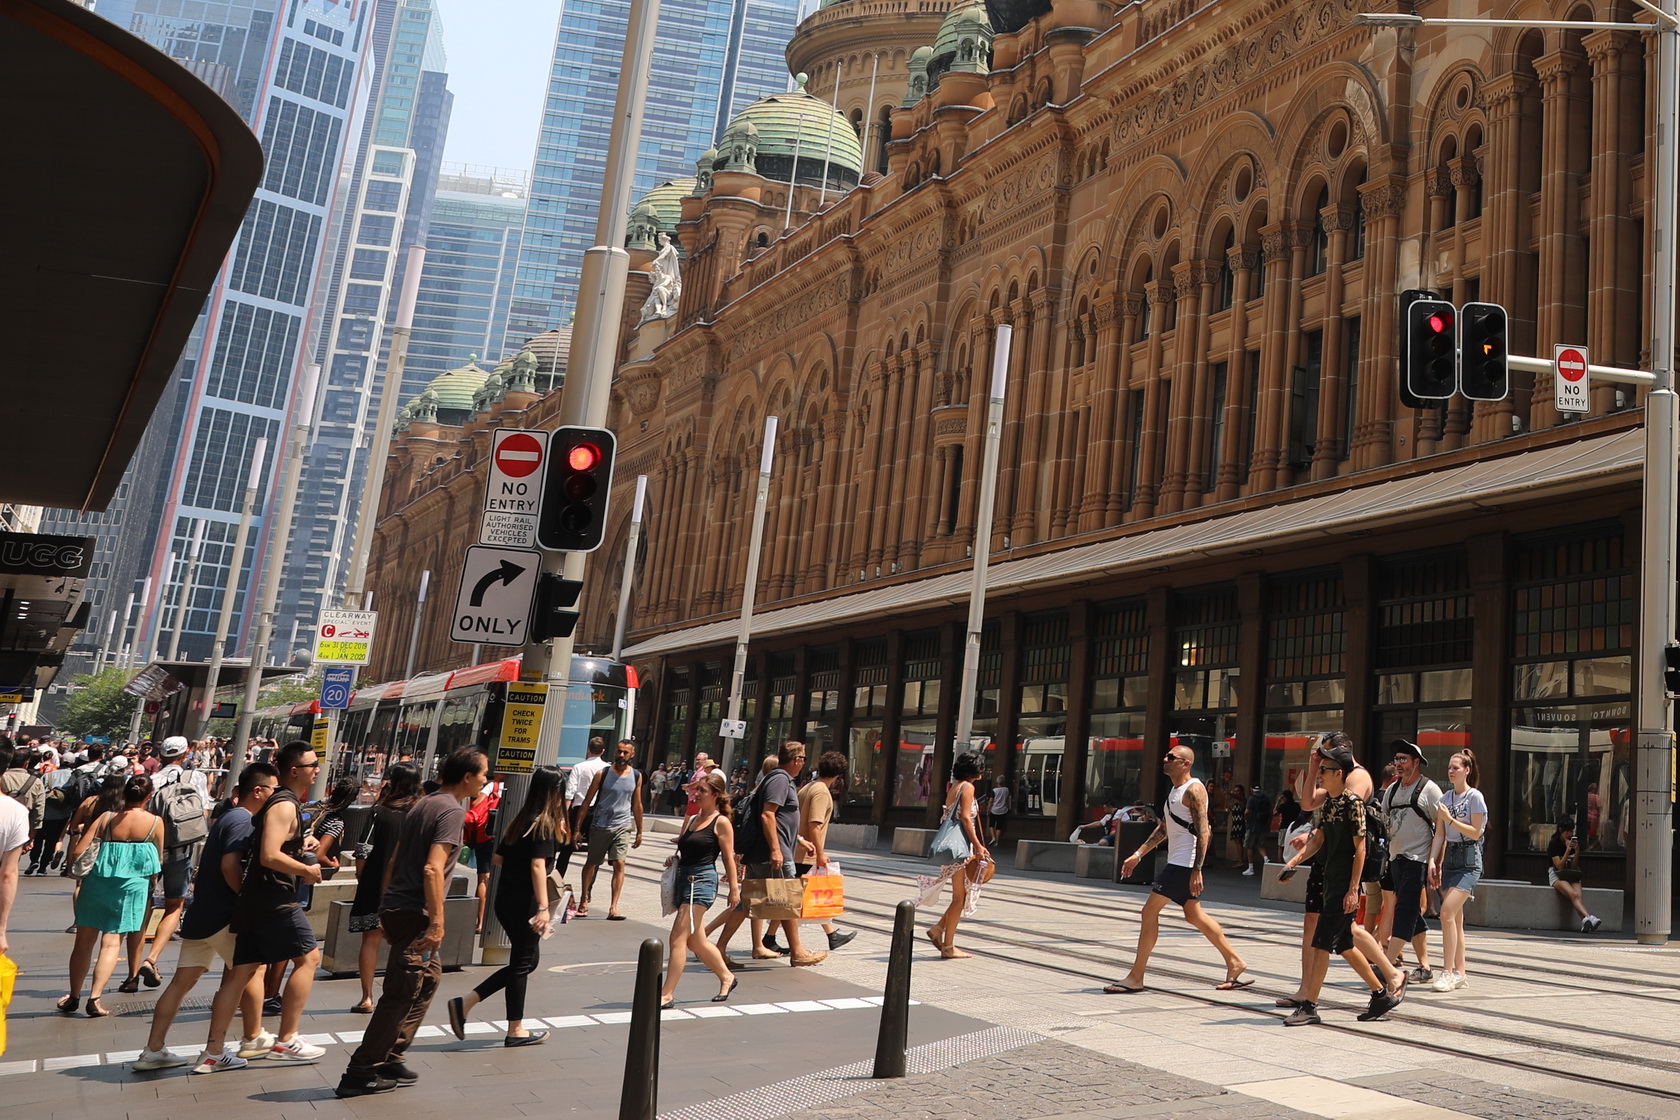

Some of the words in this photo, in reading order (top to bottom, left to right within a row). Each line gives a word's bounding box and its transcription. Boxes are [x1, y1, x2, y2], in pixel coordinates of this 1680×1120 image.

[1564, 385, 1580, 395] NO
[1559, 397, 1586, 407] ENTRY
[502, 483, 528, 496] NO
[490, 499, 536, 511] ENTRY
[489, 515, 512, 523] LIGHT
[514, 516, 532, 524] RAIL
[486, 521, 534, 531] AUTHORISED
[490, 528, 527, 538] VEHICLES
[487, 536, 527, 544] EXCEPTED
[2, 542, 83, 569] UGG
[459, 615, 522, 635] ONLY
[327, 690, 342, 701] 20
[509, 694, 545, 703] CAUTION
[566, 689, 606, 702] ndwick
[513, 710, 535, 718] CHECK
[512, 718, 533, 726] TWICE
[508, 736, 531, 744] TRAMS
[500, 750, 533, 759] CAUTION
[811, 890, 834, 905] T2
